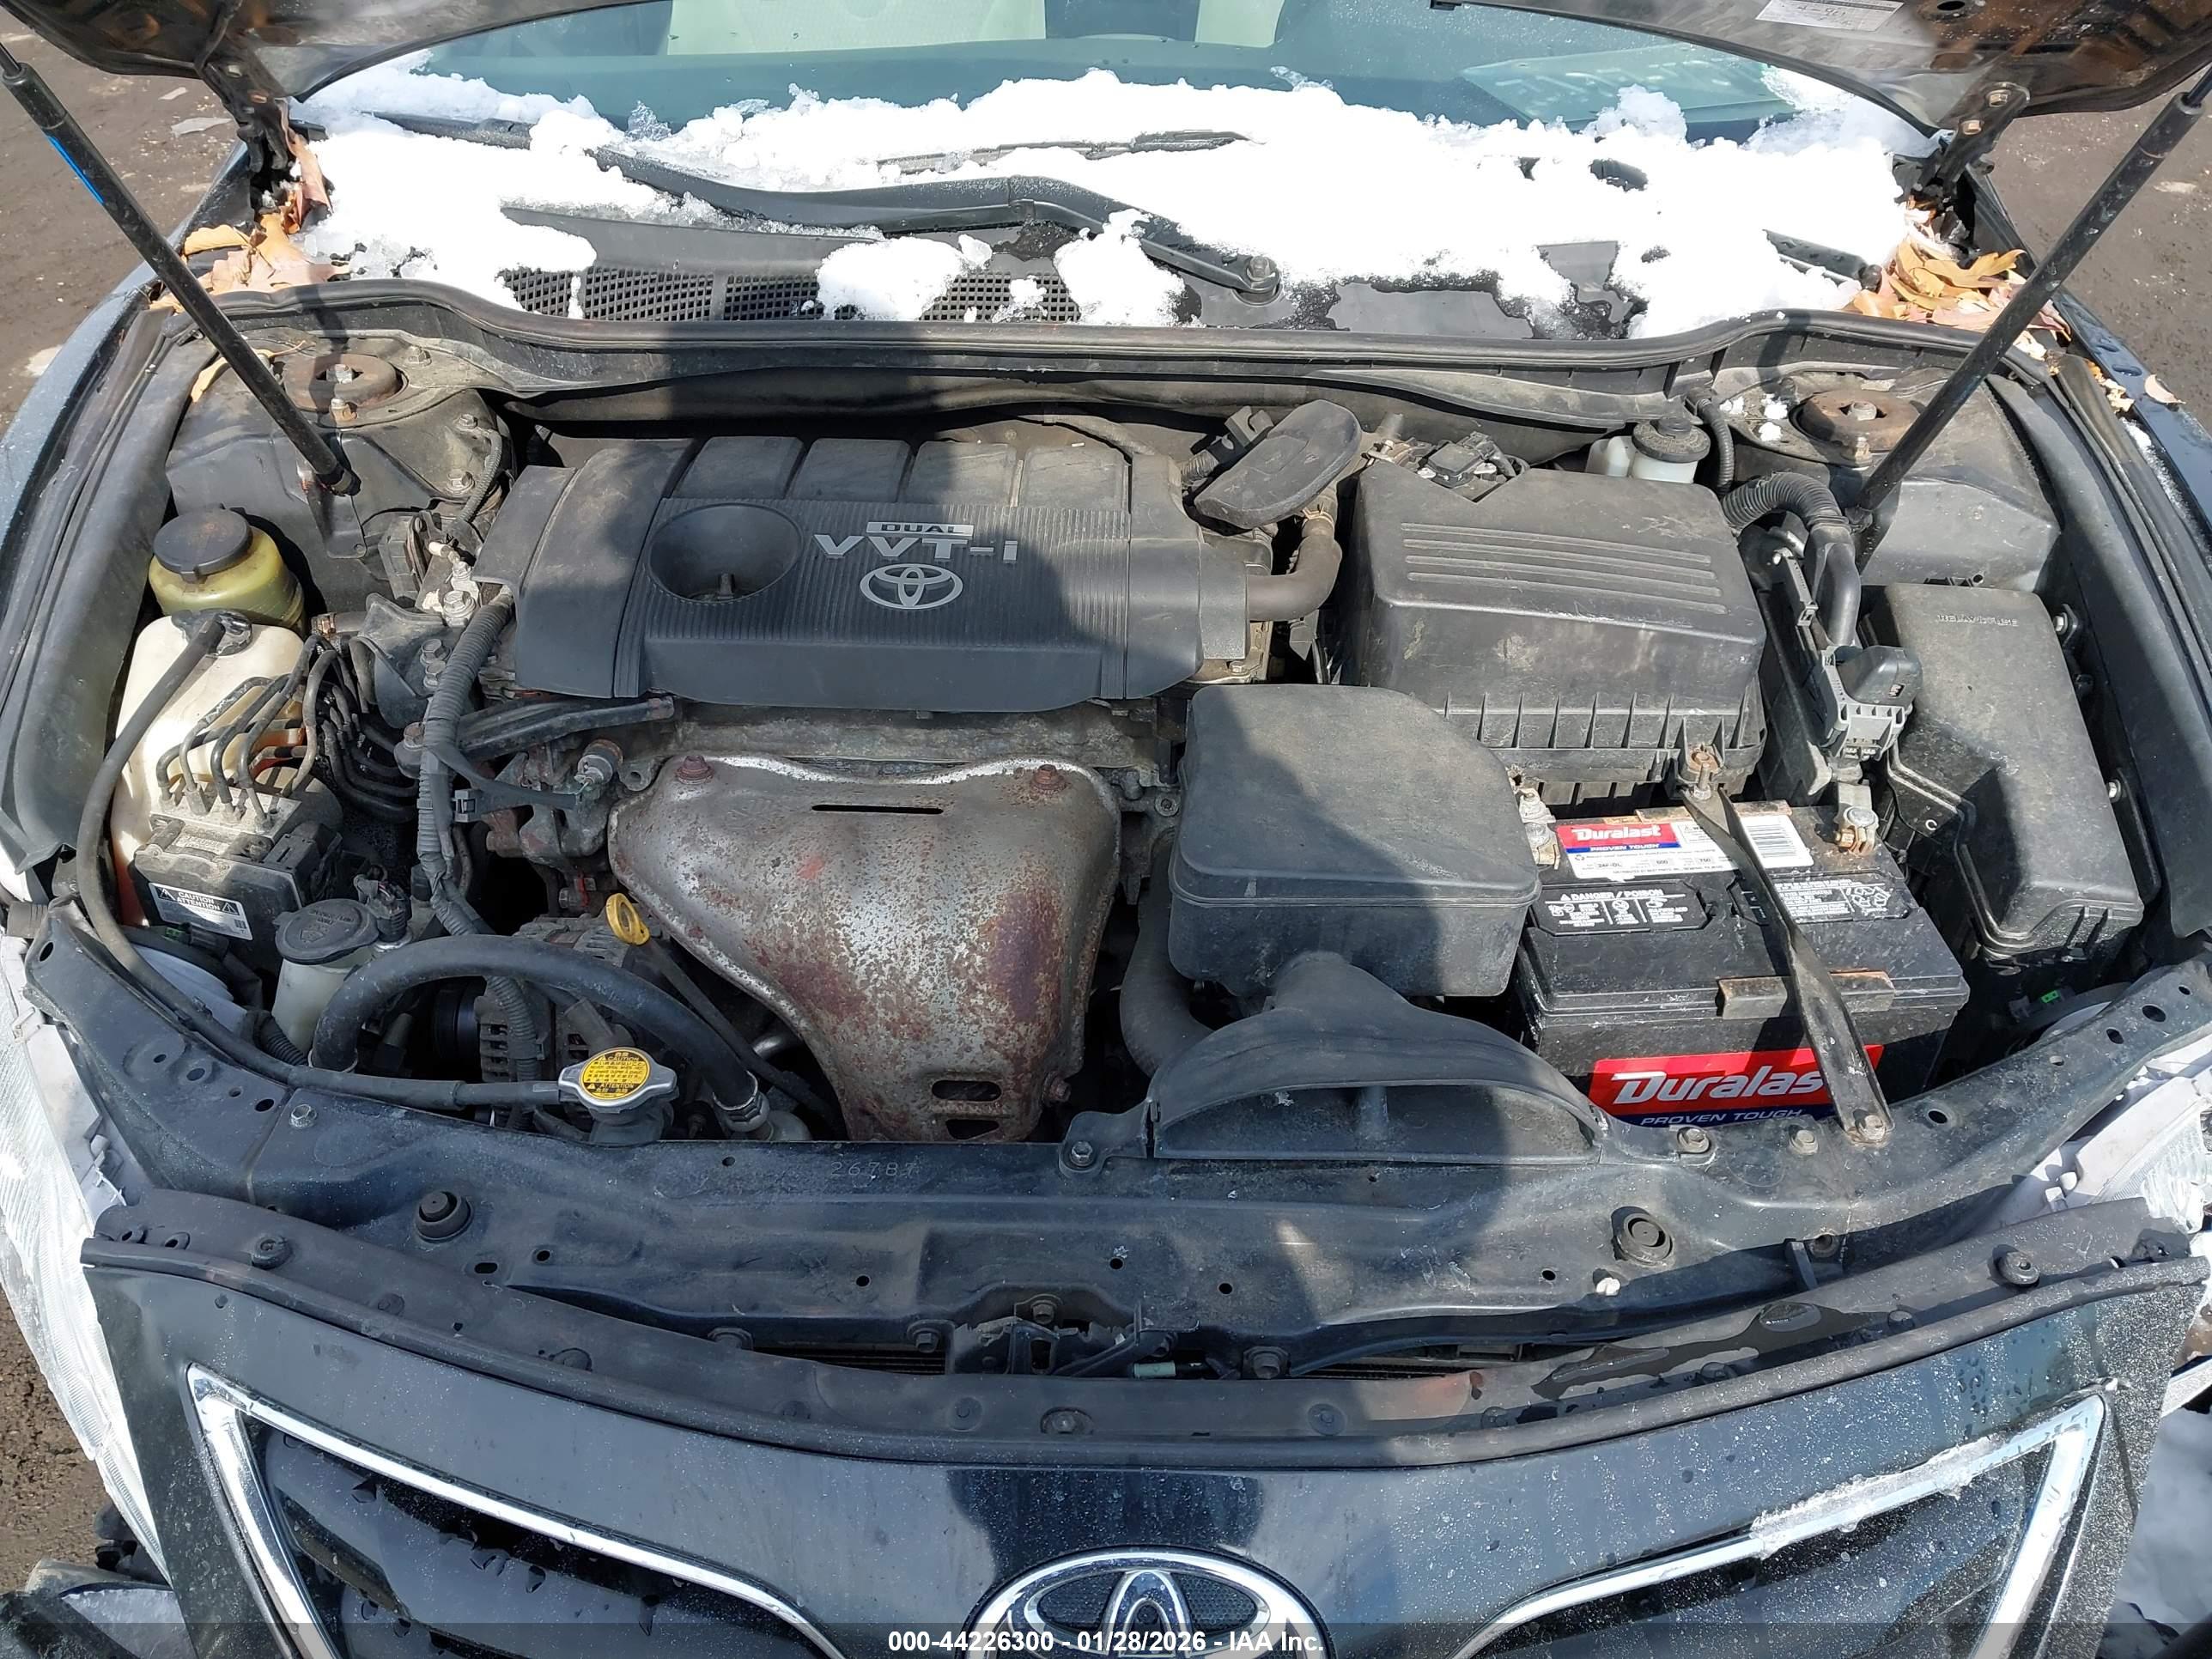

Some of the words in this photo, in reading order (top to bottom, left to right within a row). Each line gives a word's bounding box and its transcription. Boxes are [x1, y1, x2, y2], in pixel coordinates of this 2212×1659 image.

[880, 523, 963, 535] DUAL
[814, 534, 1019, 561] VVT-i
[1571, 825, 1661, 842] Duralast
[177, 897, 221, 911] ATTENTION
[178, 892, 215, 904] CAUTION
[1571, 892, 1614, 901] DANGER
[1612, 1066, 1825, 1105] Duralas
[1640, 1112, 1726, 1126] PROVEN
[1734, 1109, 1802, 1121] TOUGH
